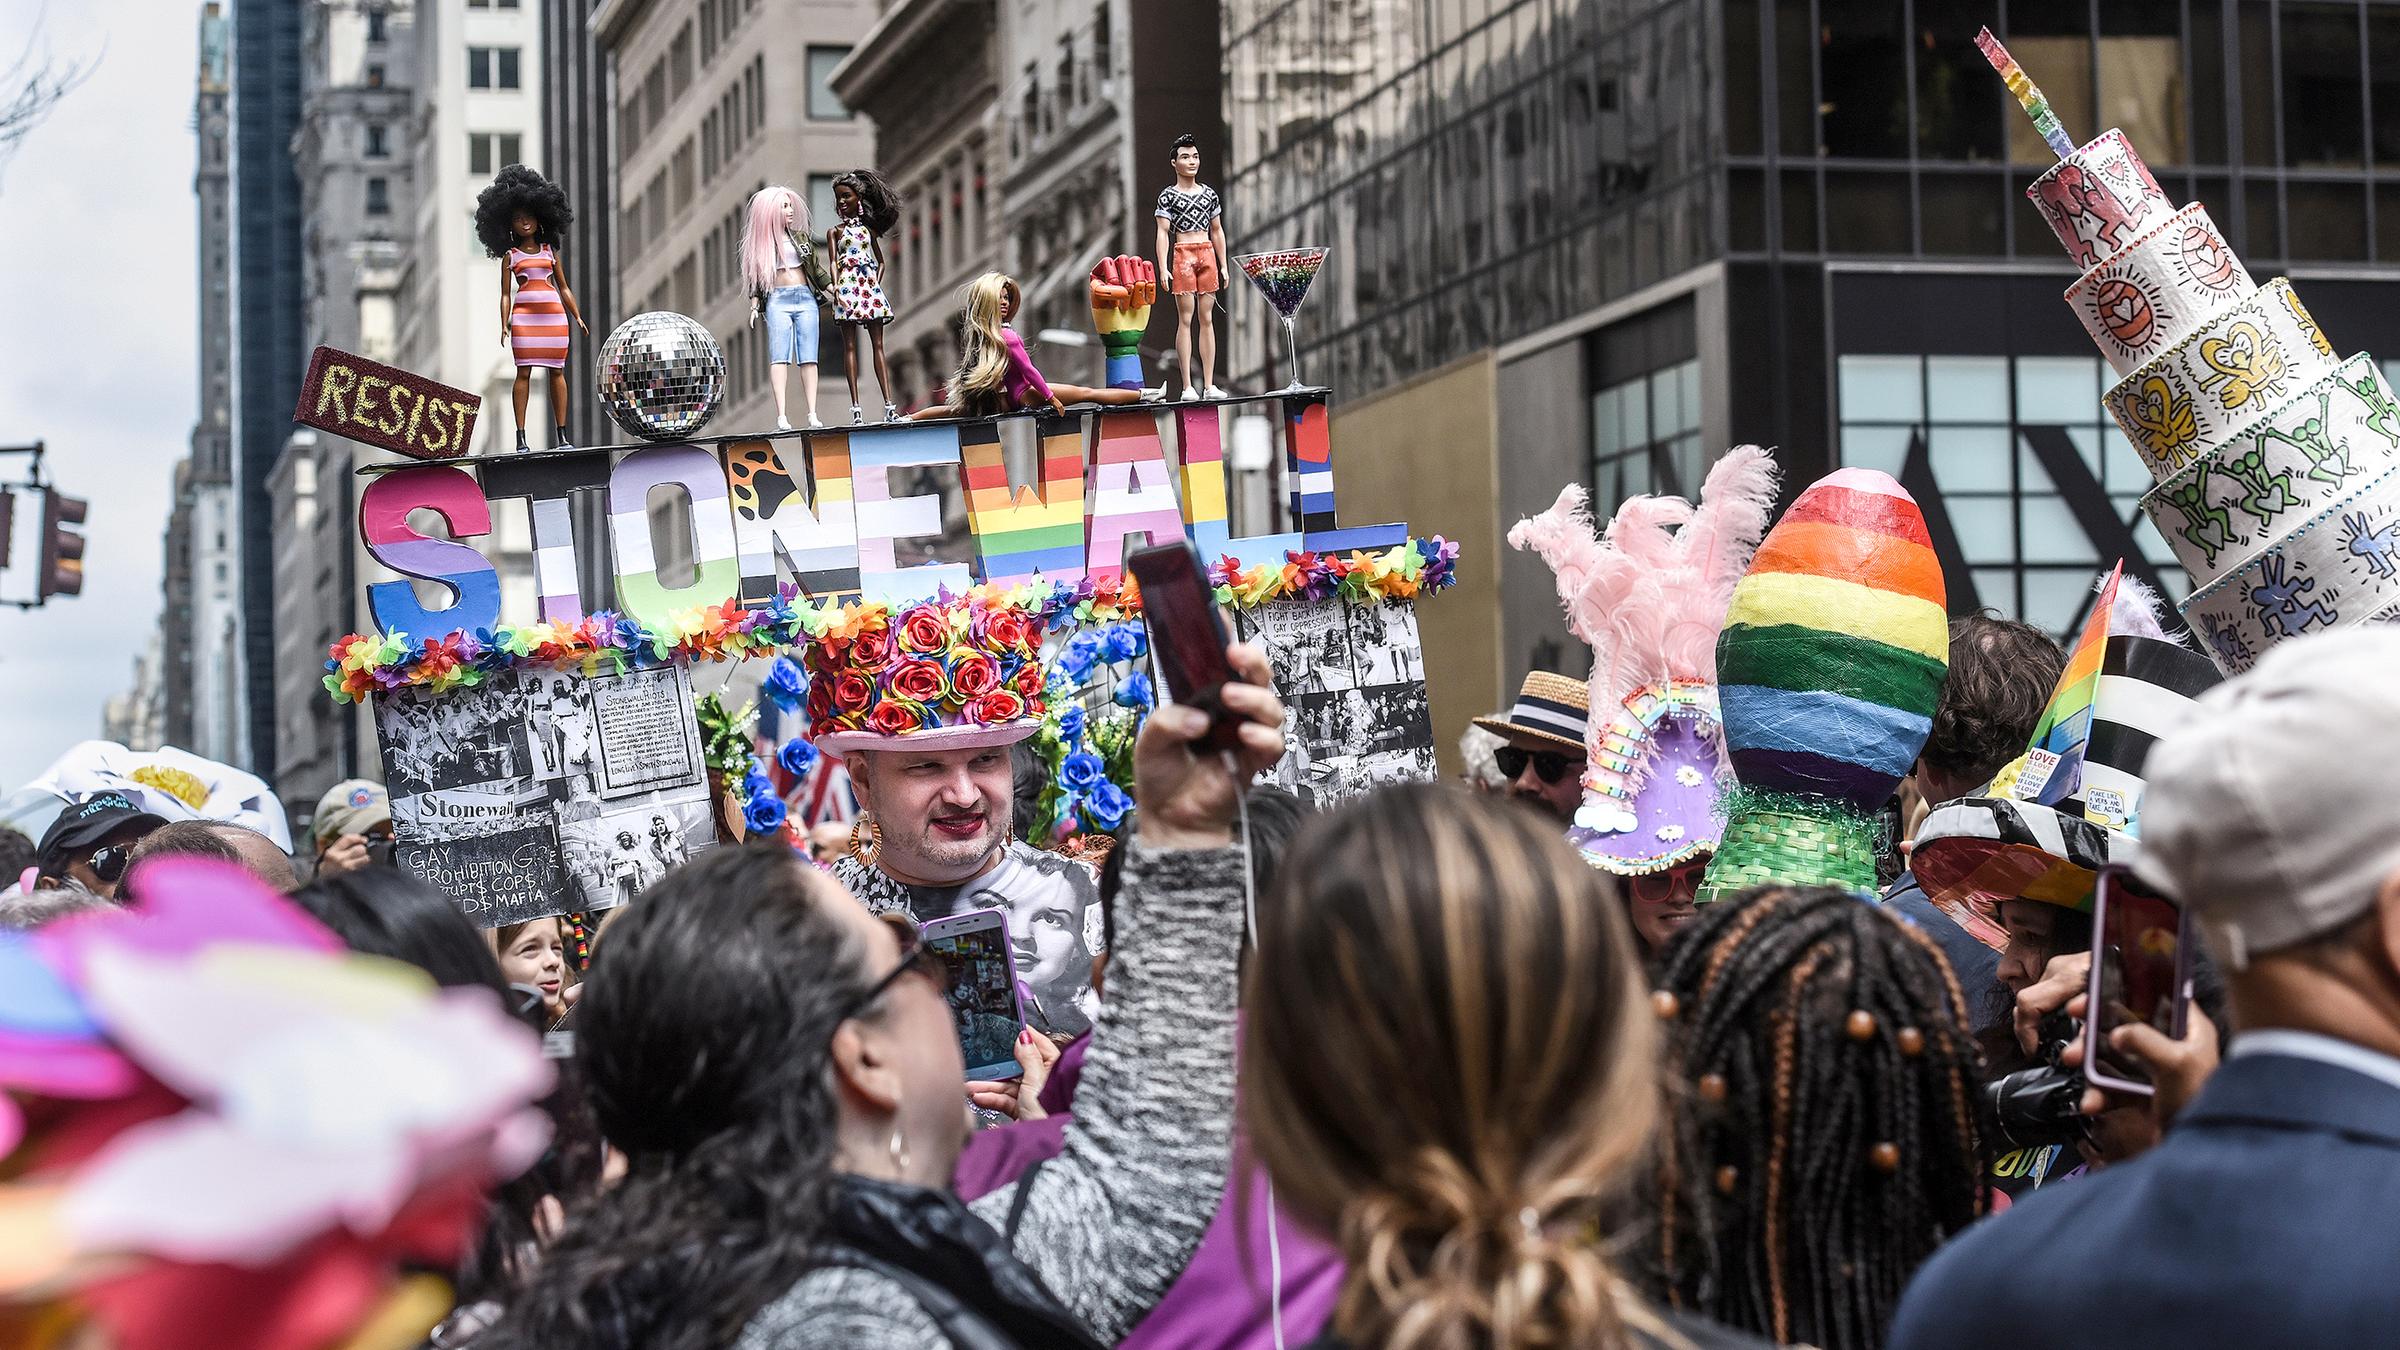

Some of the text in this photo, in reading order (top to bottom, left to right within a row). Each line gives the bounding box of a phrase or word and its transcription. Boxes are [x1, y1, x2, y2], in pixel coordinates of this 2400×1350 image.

[316, 364, 478, 453] RESIST
[360, 400, 1408, 642] STONEWALL
[1268, 611, 1290, 622] FIGHT
[1292, 609, 1315, 621] BACK!
[1315, 600, 1337, 615] SMASH
[1273, 623, 1287, 633] GAY
[1291, 613, 1336, 632] OPPRESSION!
[2030, 751, 2056, 766] LOVE
[2034, 761, 2051, 770] LOVE
[2024, 779, 2041, 789] LOVE
[2027, 773, 2045, 783] LOVE
[2021, 786, 2038, 795] LOVE
[2091, 790, 2105, 798] MAKE
[420, 793, 514, 819] Stonewall
[2089, 802, 2101, 811] TAKE
[408, 846, 451, 869] GAY
[413, 859, 513, 885] PROHIBITION
[491, 868, 536, 893] COP$
[495, 889, 545, 908] MAFIA
